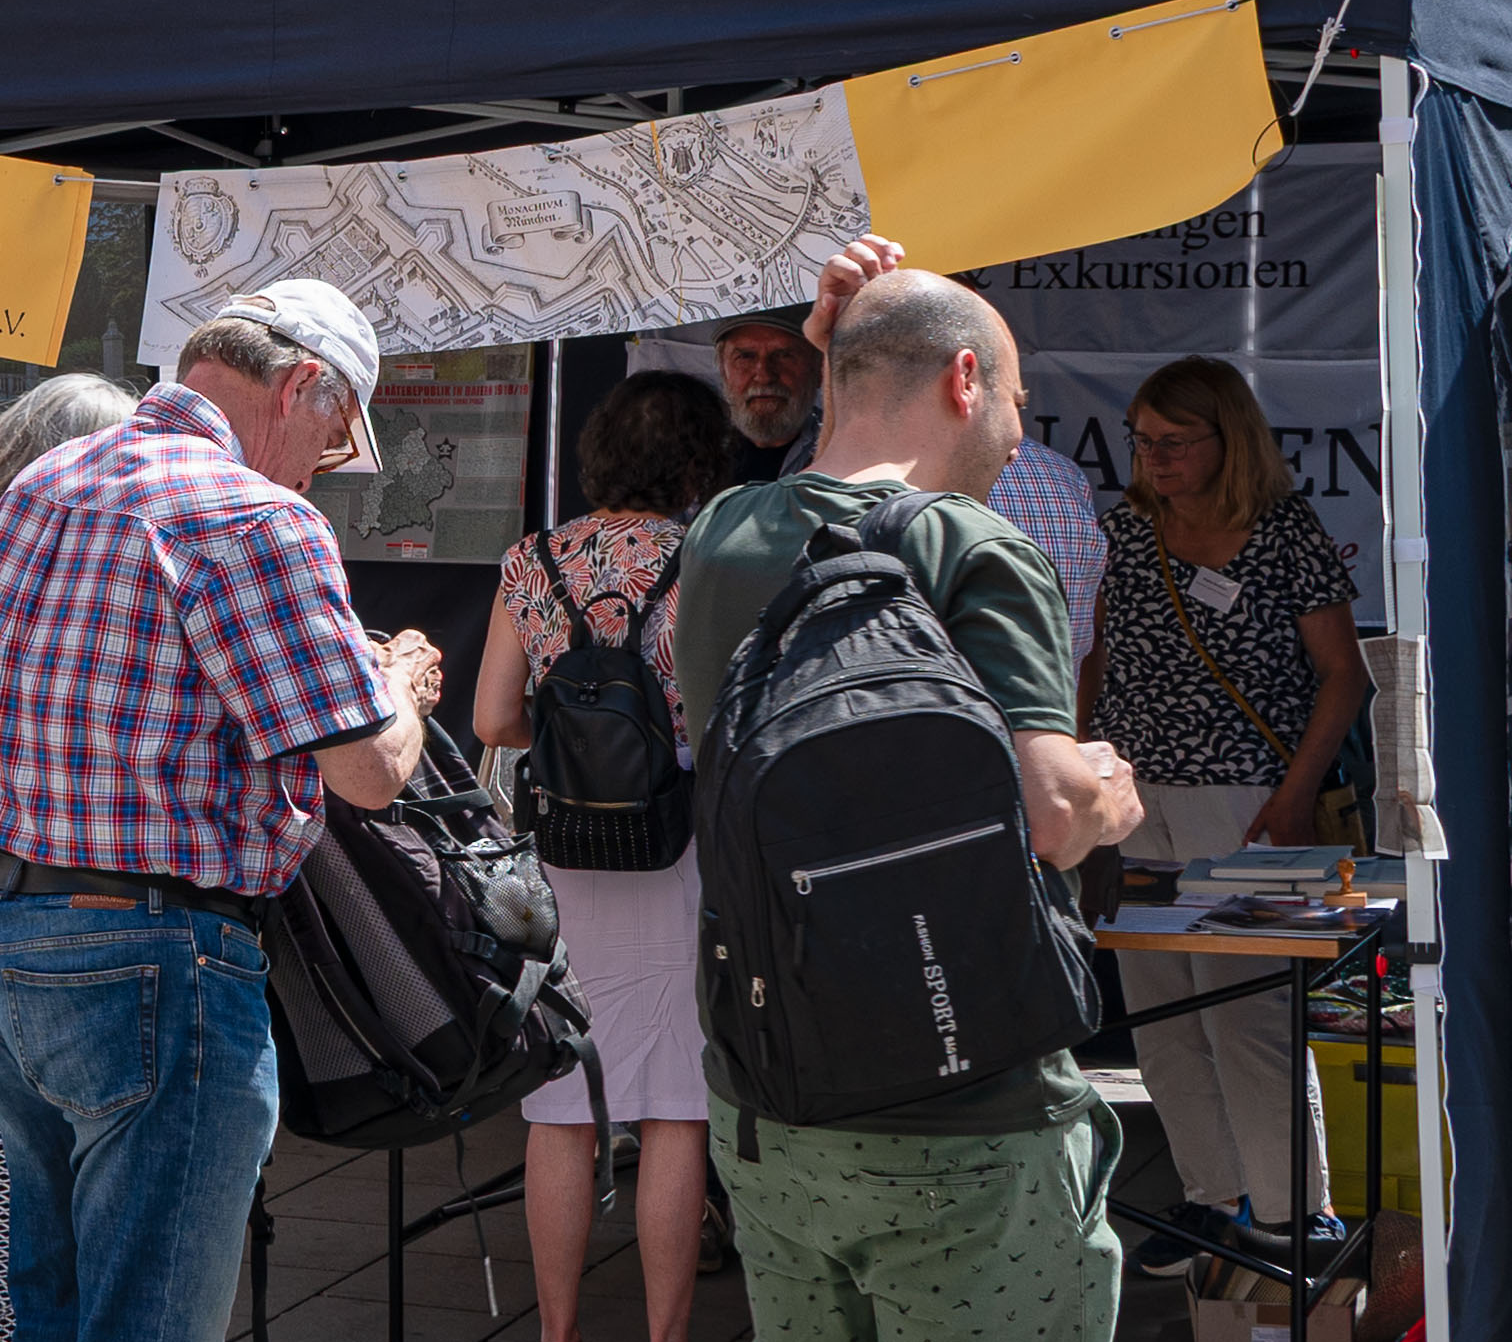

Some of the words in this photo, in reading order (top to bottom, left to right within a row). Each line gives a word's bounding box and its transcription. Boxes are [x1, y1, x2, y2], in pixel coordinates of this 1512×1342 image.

[1009, 250, 1312, 290] Exkursionen
[912, 914, 936, 961] FASHION
[924, 964, 957, 1033] SPORT
